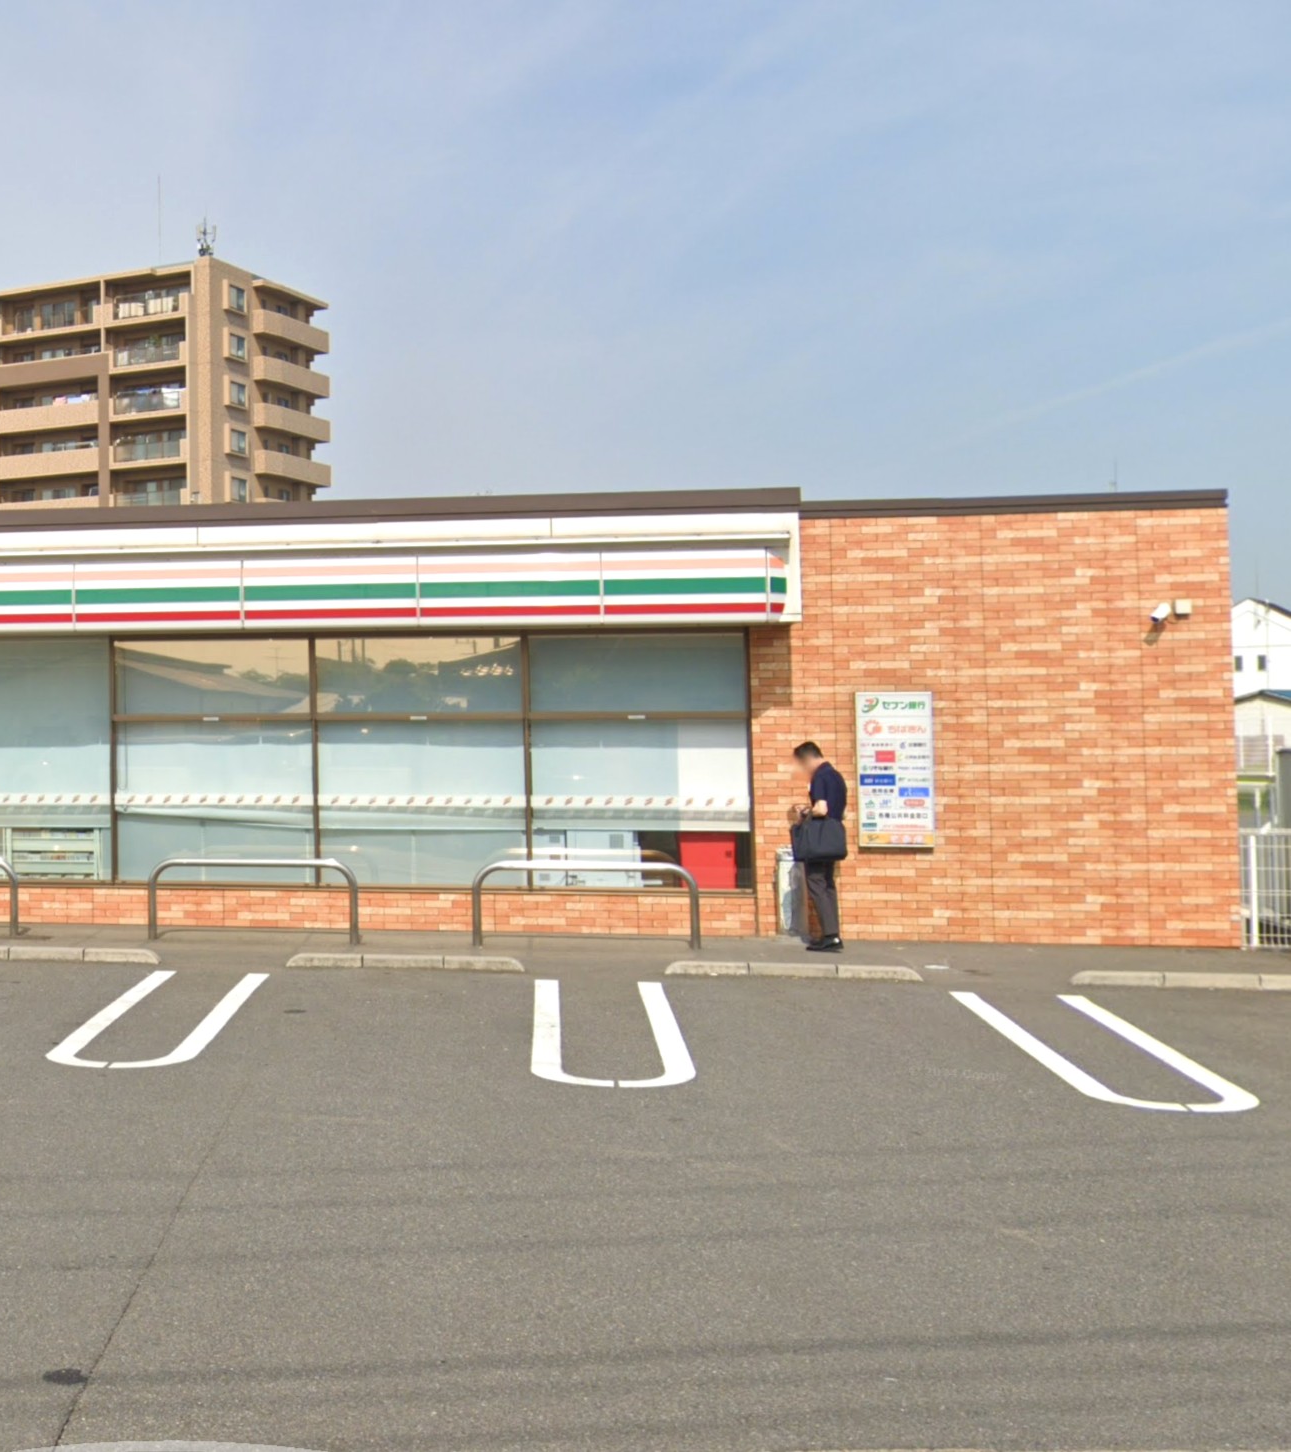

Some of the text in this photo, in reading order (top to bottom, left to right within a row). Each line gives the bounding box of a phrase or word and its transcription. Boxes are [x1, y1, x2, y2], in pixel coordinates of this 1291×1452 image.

[882, 701, 926, 710] セブン銀行
